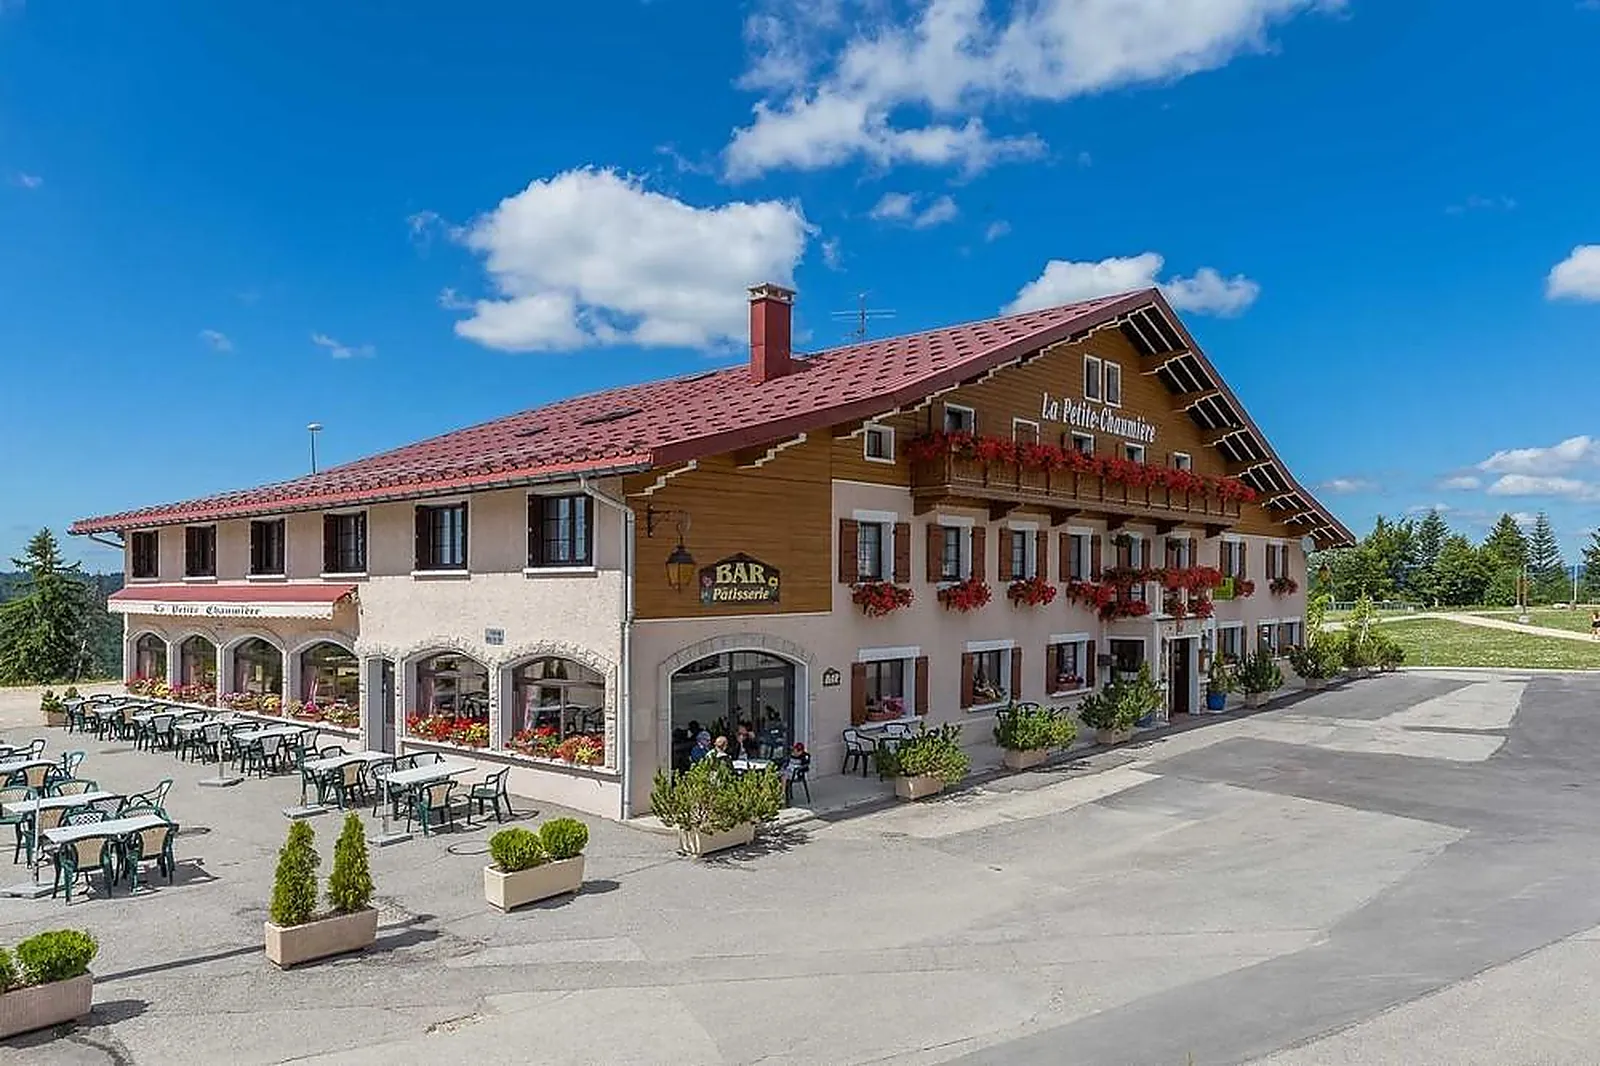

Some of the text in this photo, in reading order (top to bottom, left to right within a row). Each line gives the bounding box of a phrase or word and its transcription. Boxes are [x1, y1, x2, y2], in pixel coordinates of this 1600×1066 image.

[1042, 391, 1156, 443] La Petite Chaumière
[716, 562, 766, 584] BAR
[712, 587, 769, 601] Pâtisserie
